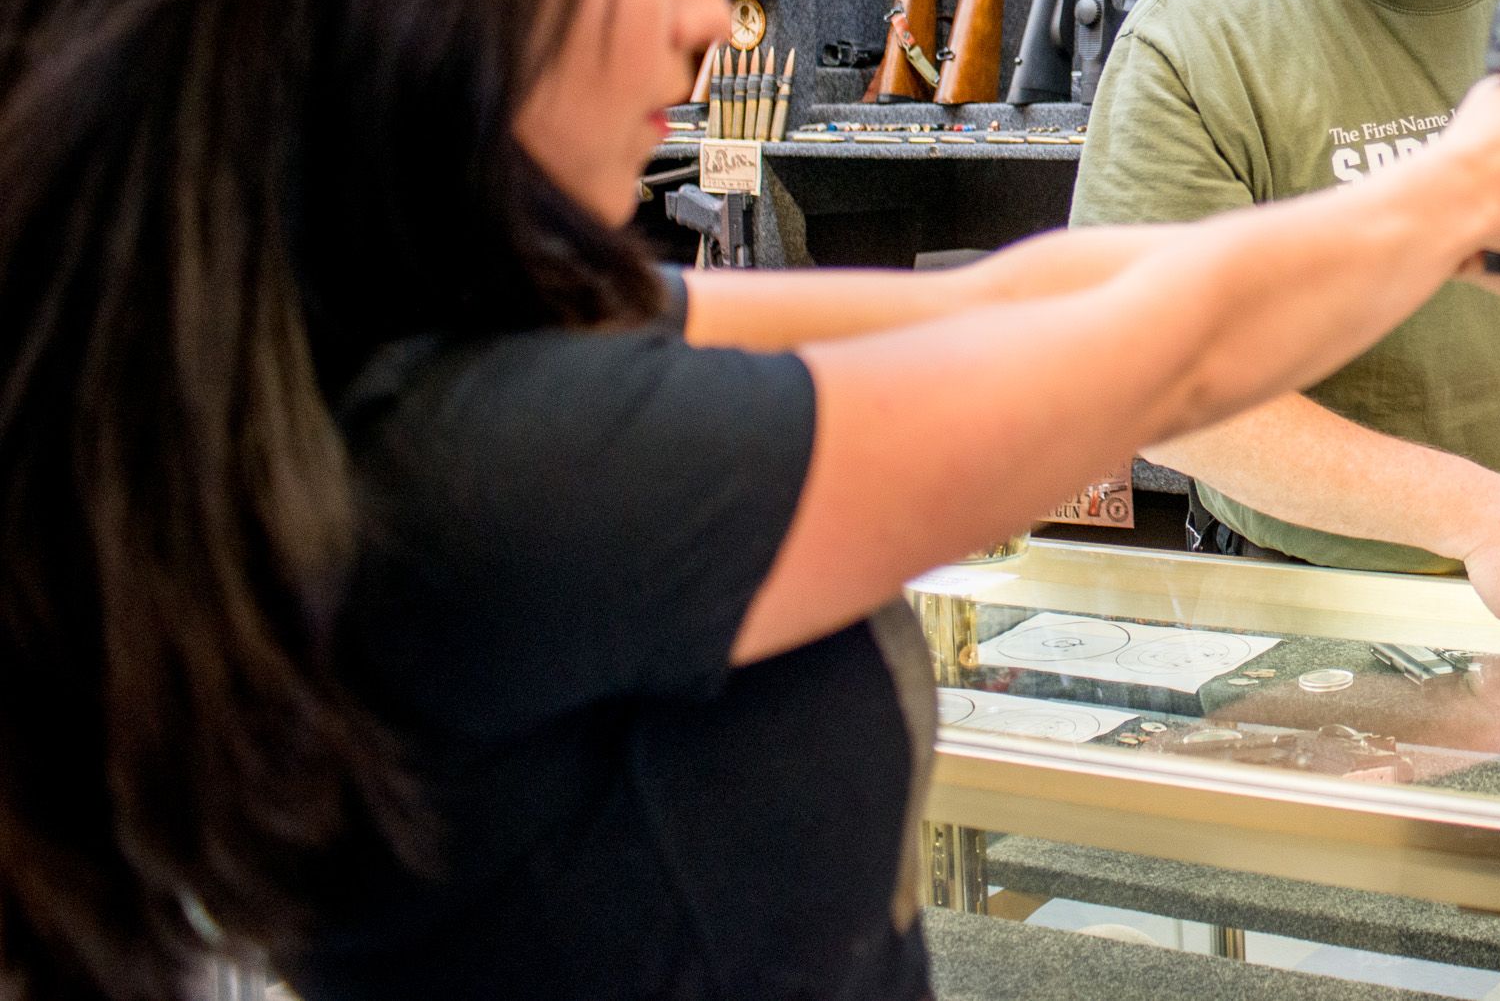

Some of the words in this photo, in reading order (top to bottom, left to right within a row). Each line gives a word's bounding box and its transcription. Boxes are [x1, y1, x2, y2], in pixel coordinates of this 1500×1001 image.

[1329, 127, 1361, 146] The
[1361, 119, 1400, 140] First
[1399, 113, 1449, 135] Name
